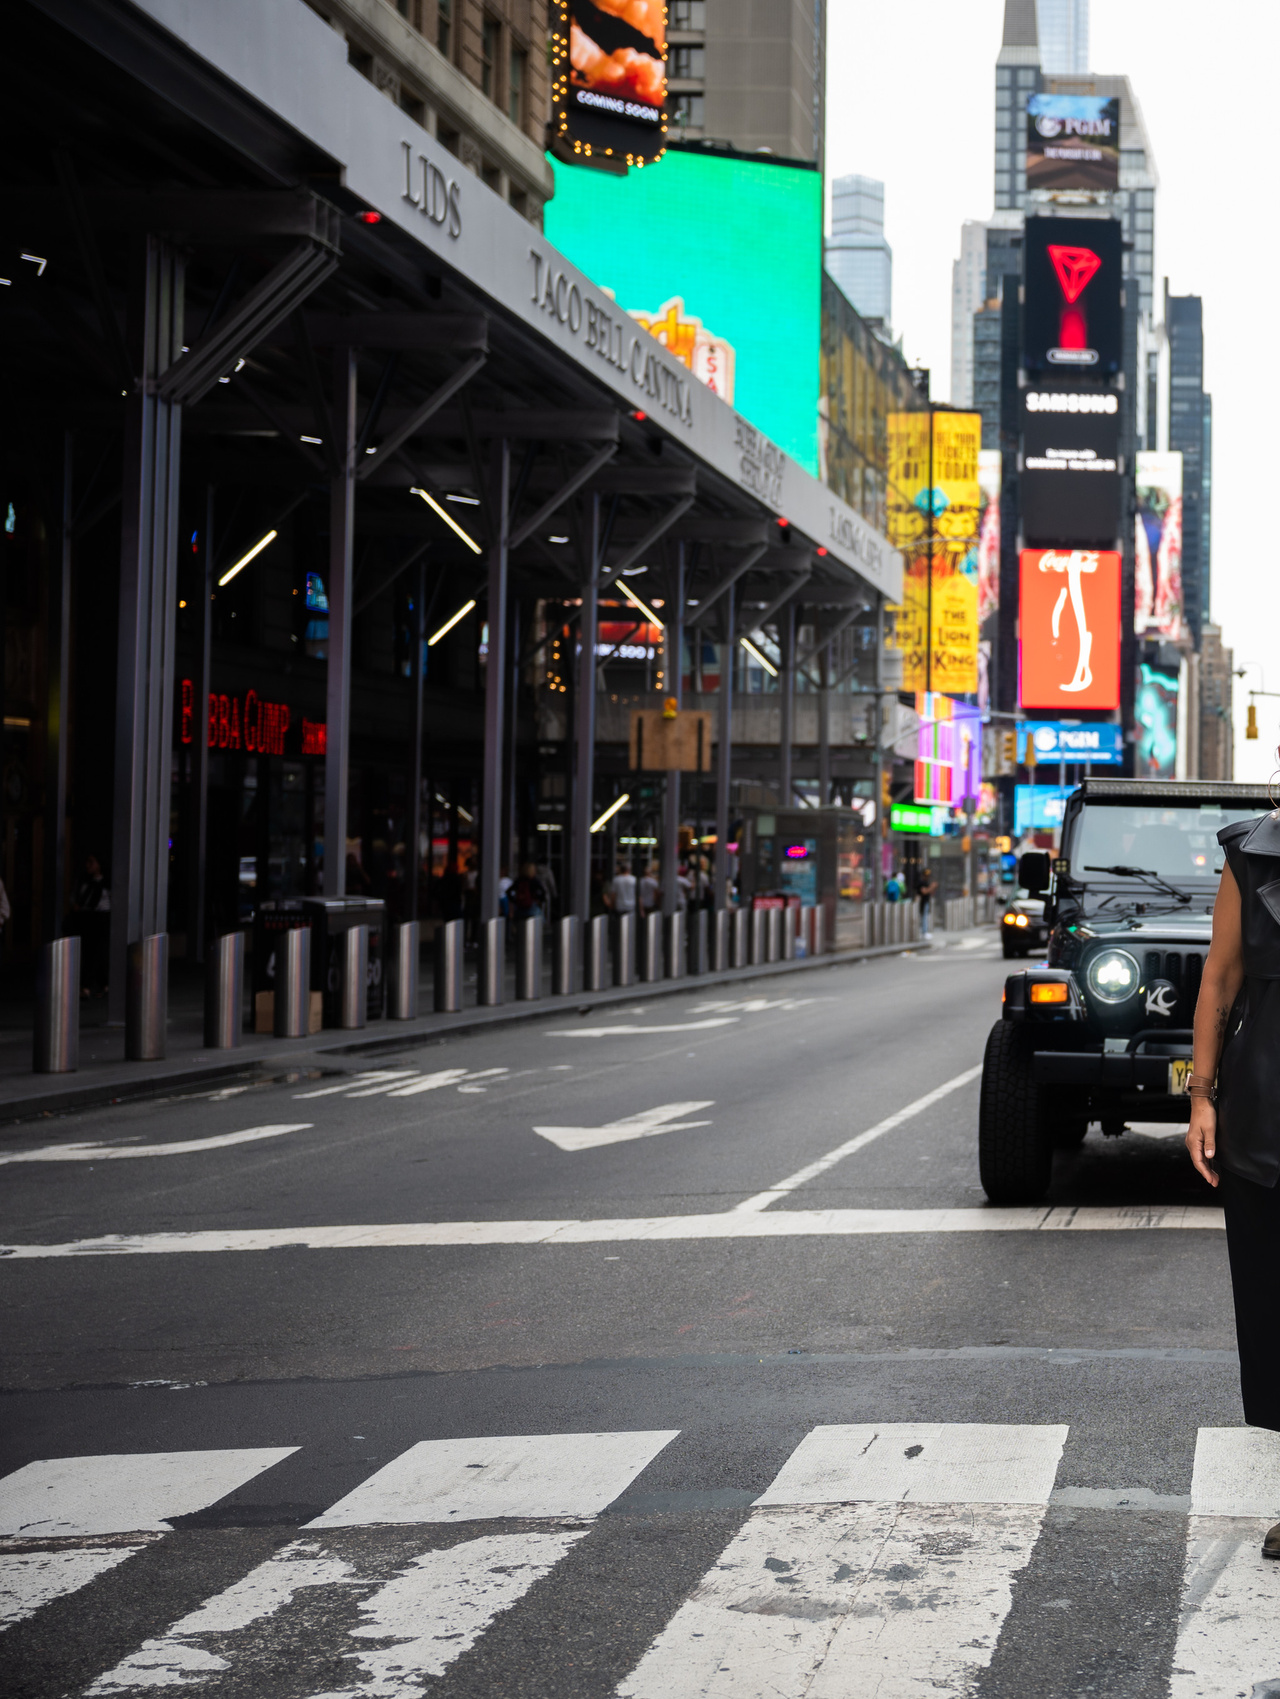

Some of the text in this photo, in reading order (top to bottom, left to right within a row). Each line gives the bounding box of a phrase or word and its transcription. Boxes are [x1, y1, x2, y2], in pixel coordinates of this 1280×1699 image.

[577, 90, 659, 122] COMING SOON
[1065, 118, 1111, 136] PGIM
[401, 140, 462, 239] LIDS
[530, 249, 693, 428] TACO BELL CANTINA
[1026, 391, 1118, 414] SAMSUNG
[937, 461, 977, 480] TODAY
[943, 609, 966, 620] THE
[1058, 731, 1100, 749] PGIM
[1145, 986, 1178, 1016] KC
